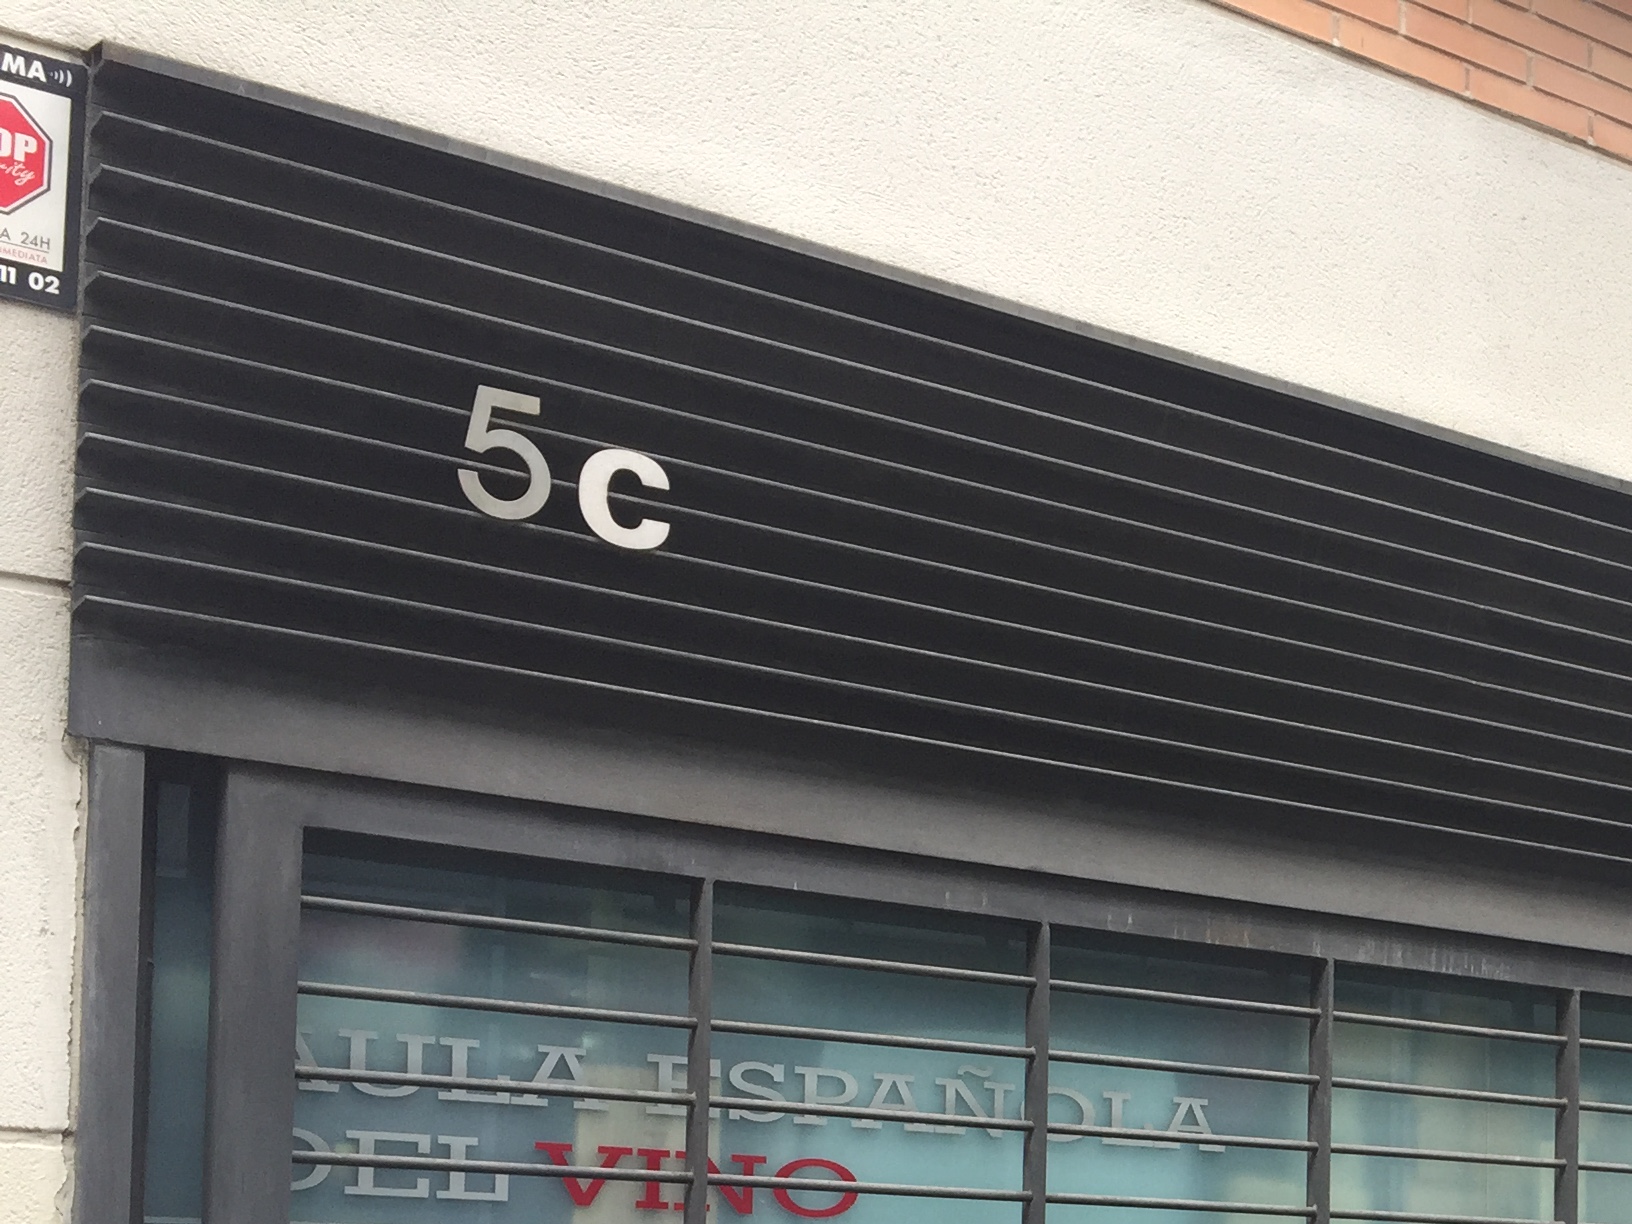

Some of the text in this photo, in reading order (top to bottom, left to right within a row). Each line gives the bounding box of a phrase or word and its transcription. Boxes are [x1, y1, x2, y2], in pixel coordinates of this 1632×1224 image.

[20, 231, 51, 250] 24H
[0, 246, 48, 264] MEDIATA
[28, 271, 60, 295] 02
[645, 1053, 1226, 1152] ESPAÑOLA
[534, 1141, 859, 1218] VINO
